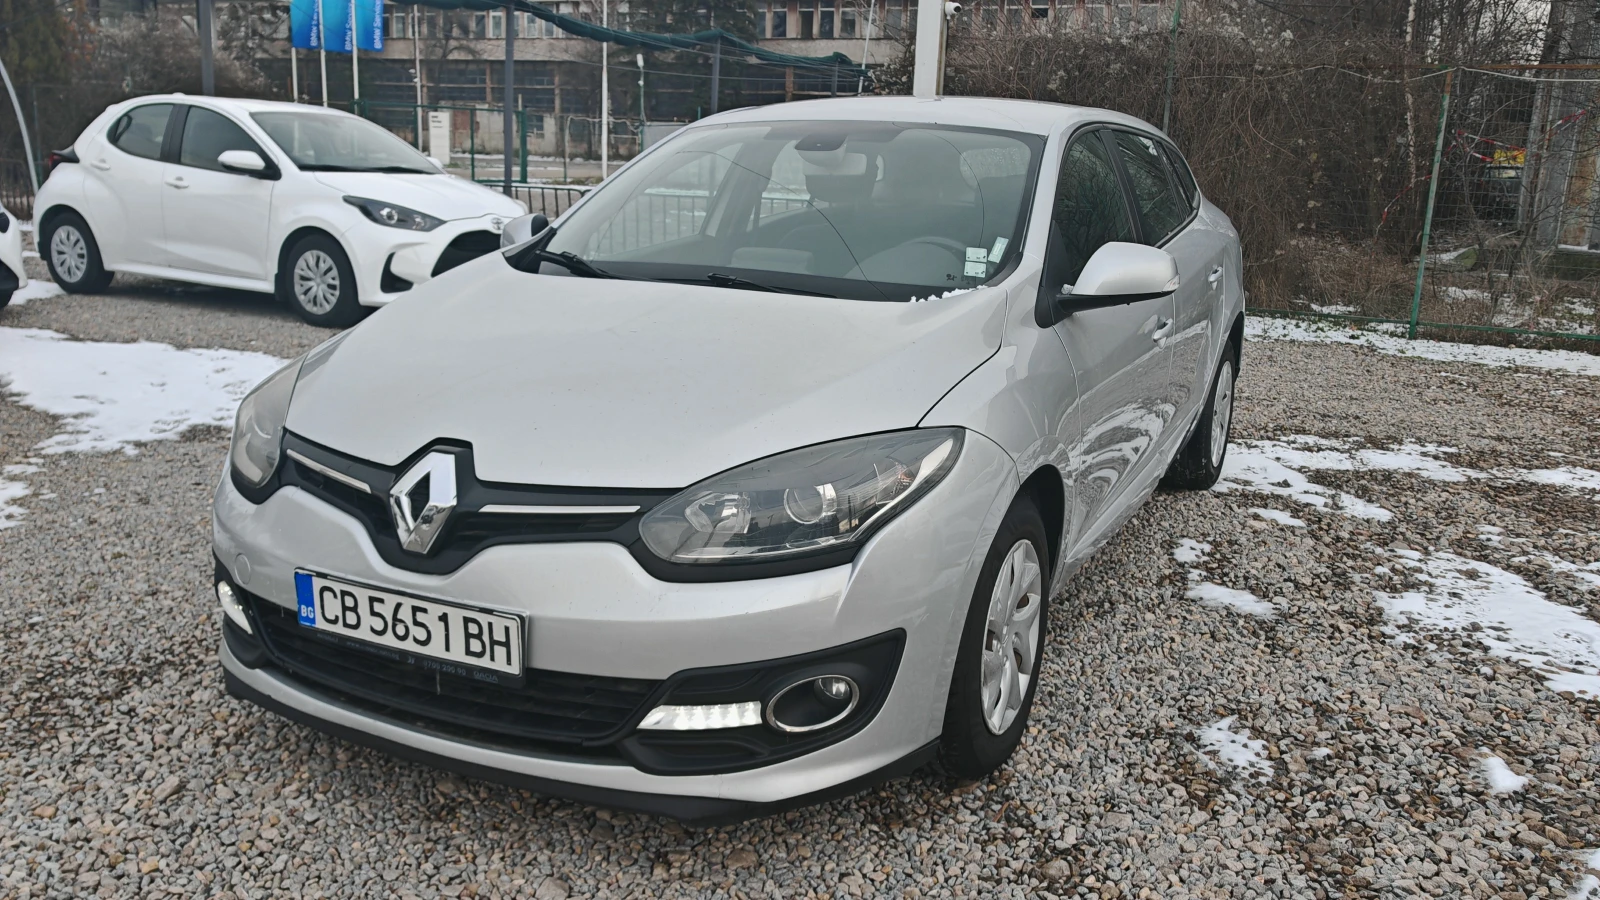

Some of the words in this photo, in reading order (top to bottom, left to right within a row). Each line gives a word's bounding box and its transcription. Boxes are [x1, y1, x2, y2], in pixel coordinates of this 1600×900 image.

[374, 28, 382, 49] BMW
[301, 604, 314, 619] BG
[319, 585, 361, 630] CB
[368, 596, 450, 652] 5651
[462, 616, 512, 666] BH
